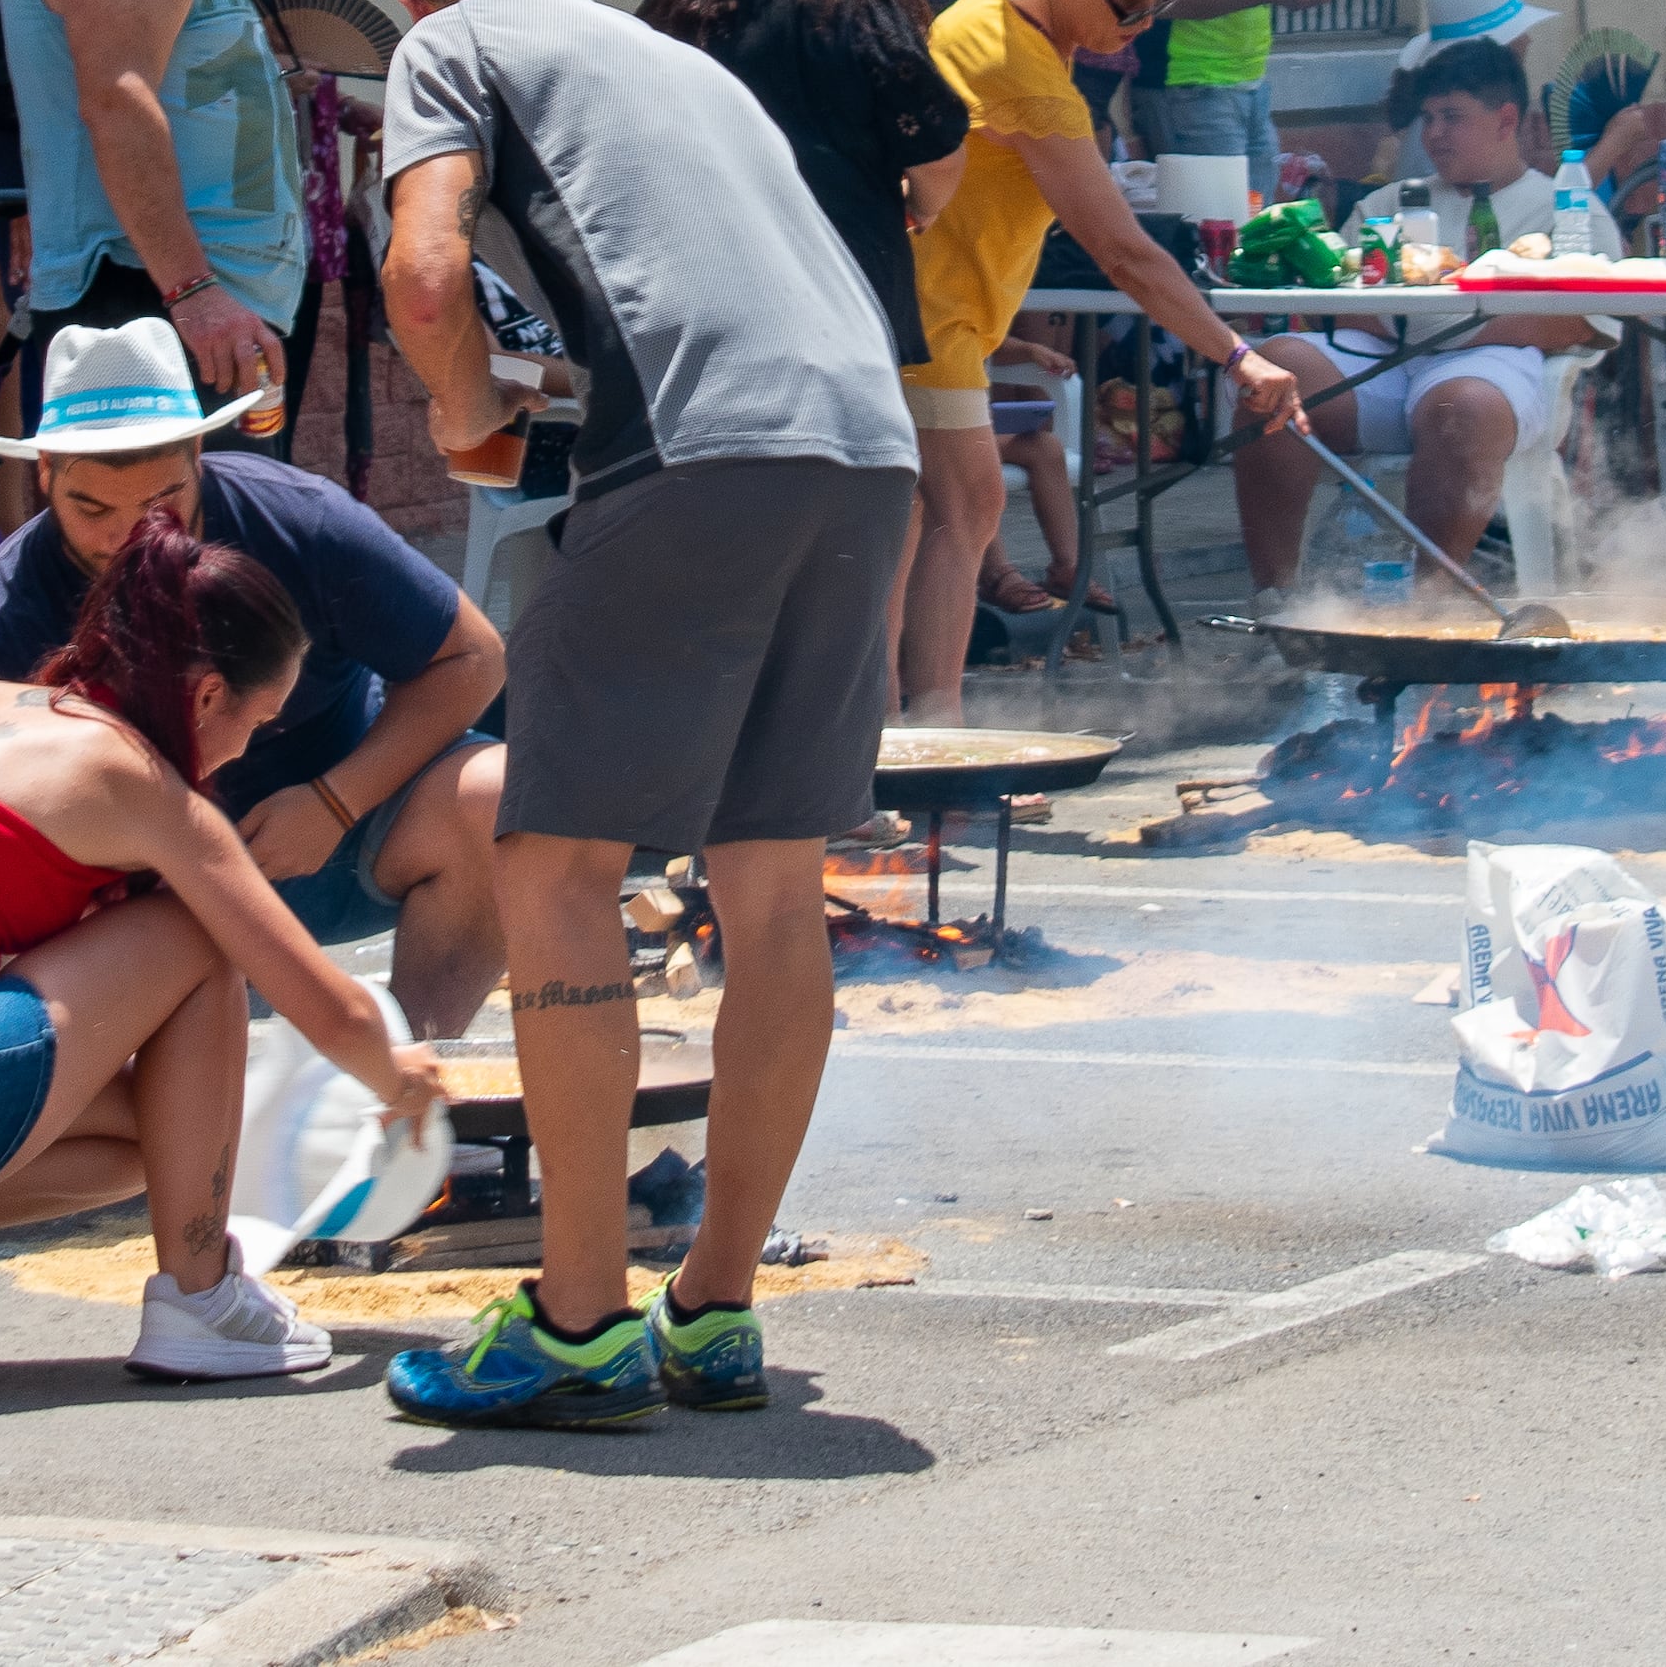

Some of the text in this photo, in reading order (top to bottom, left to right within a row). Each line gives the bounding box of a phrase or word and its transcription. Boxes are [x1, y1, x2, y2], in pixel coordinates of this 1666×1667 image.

[1642, 905, 1665, 951] VIVA
[1468, 923, 1493, 990] ARENA
[1529, 1100, 1580, 1132] VIVA
[1582, 1079, 1662, 1128] ARENA
